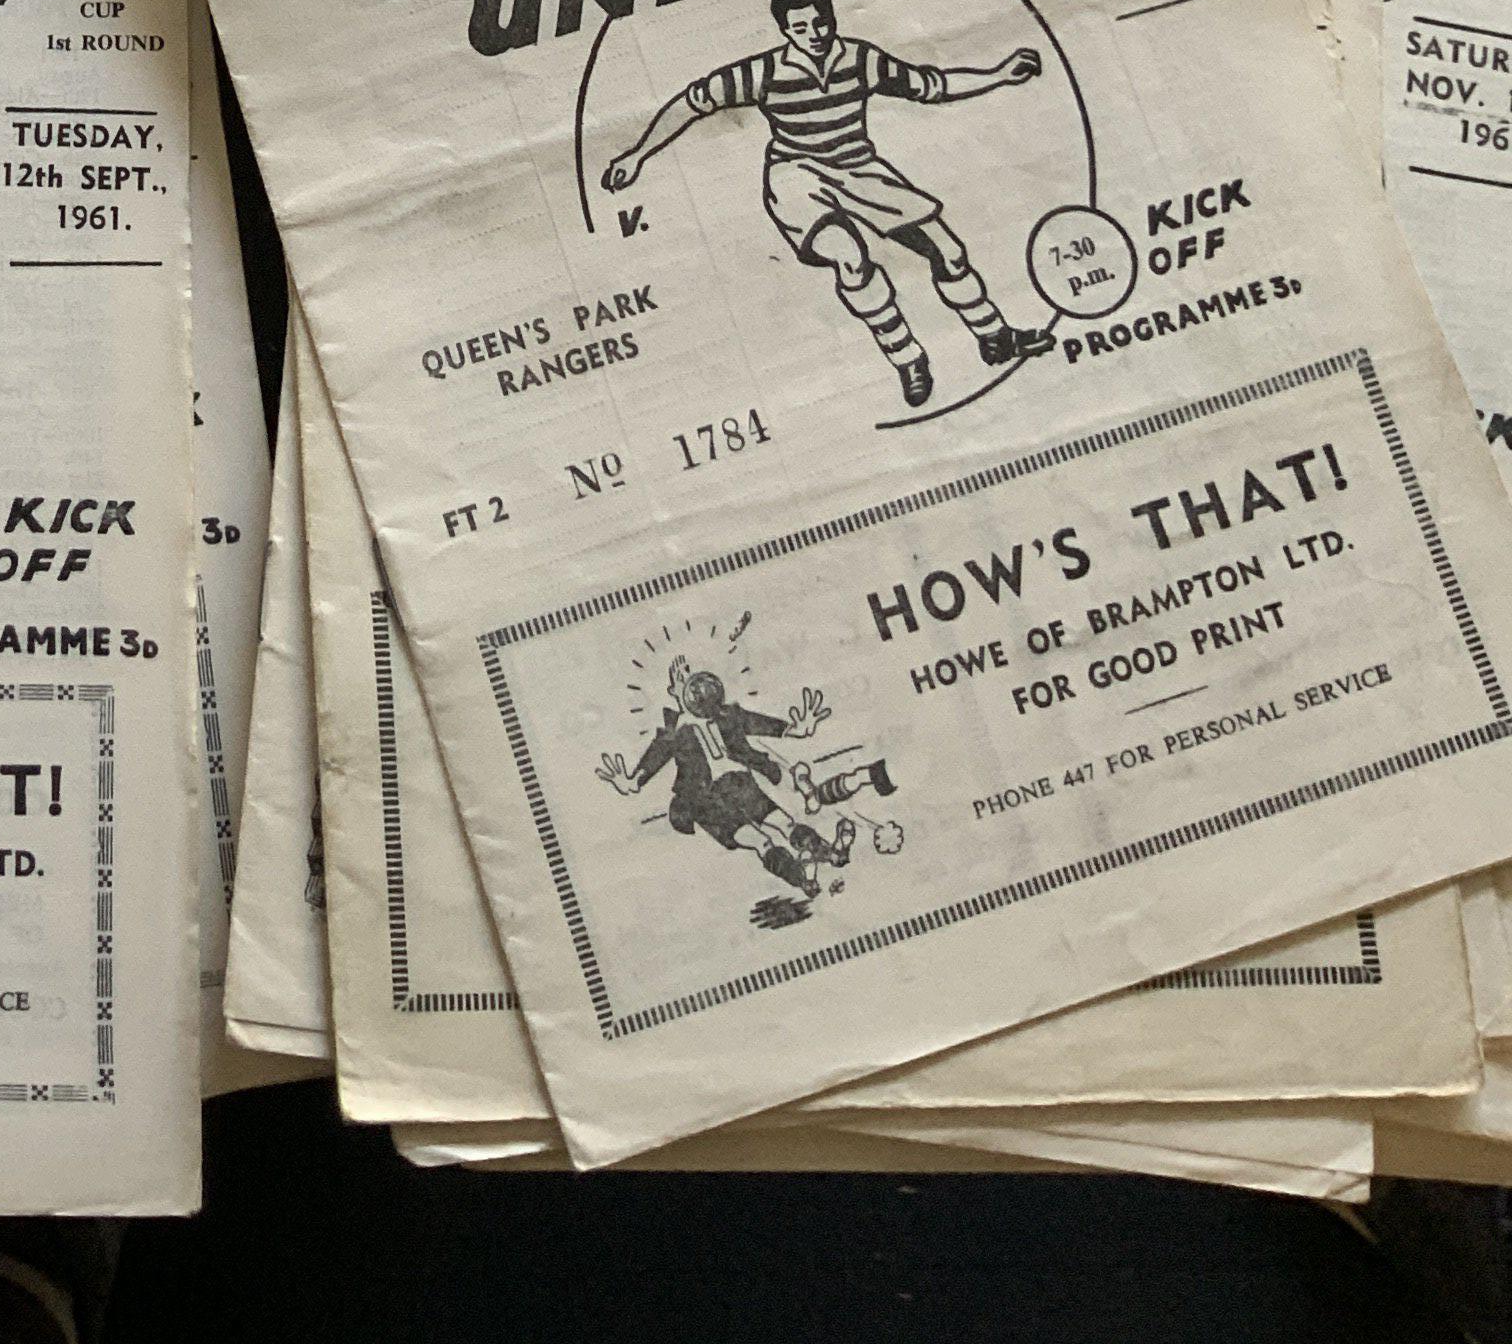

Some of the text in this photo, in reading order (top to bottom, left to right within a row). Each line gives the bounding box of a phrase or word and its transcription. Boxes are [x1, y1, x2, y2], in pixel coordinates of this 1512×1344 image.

[80, 2, 125, 18] CUP
[82, 35, 165, 51] ROUND
[13, 122, 163, 152] TUESDAY,
[58, 205, 131, 230] 1961.
[422, 285, 658, 385] QUEEN'S PARK
[1063, 277, 1267, 364] PROGRAMME
[497, 322, 638, 396] RANGERS
[673, 409, 771, 470] 1784
[867, 444, 1353, 649] HOW'S THAT!
[1087, 556, 1268, 642] BRAMPTON
